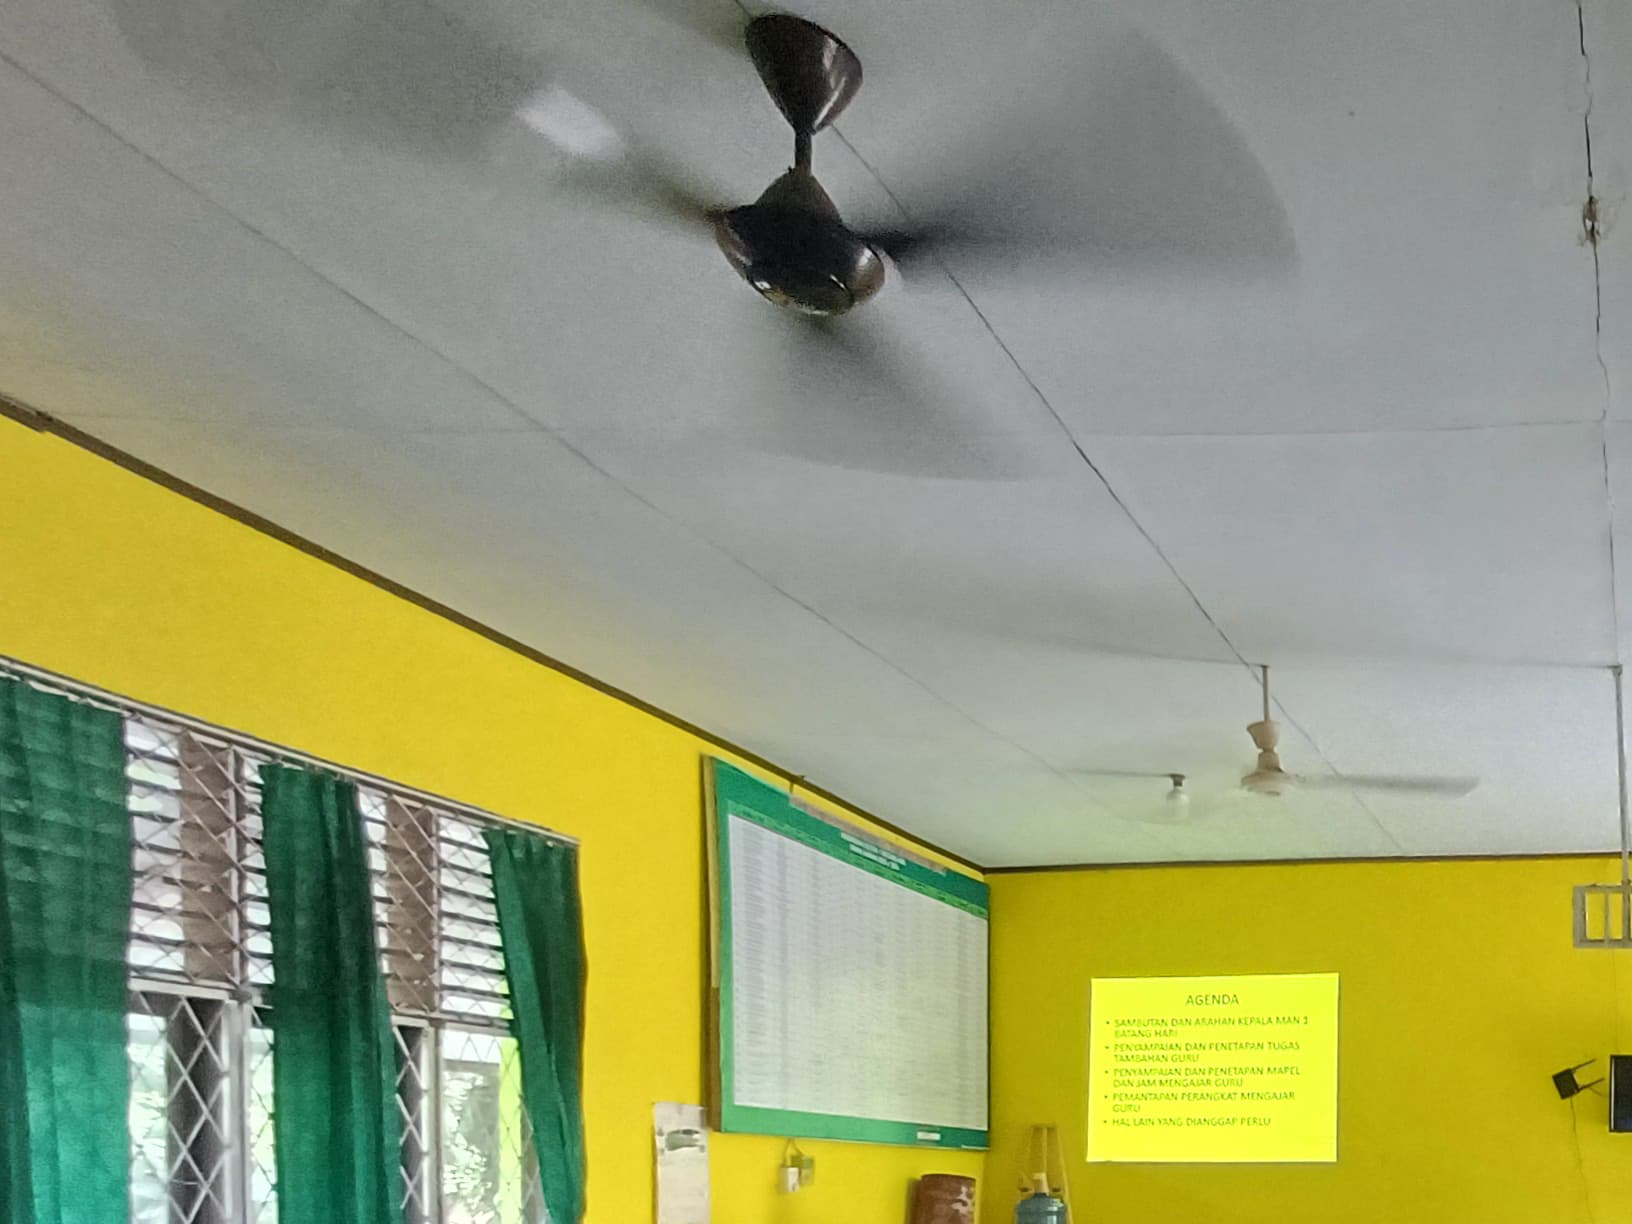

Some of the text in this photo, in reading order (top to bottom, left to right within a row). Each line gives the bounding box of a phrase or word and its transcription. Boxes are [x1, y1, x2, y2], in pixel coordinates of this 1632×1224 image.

[1185, 994, 1239, 1006] AGENDA
[1171, 1018, 1192, 1026] DAN
[1194, 1017, 1235, 1026] ARAHAN
[1238, 1017, 1273, 1025] KEPALA
[1275, 1016, 1300, 1025] MAN
[1114, 1041, 1300, 1051] PENYAMPAIAN DAN PENETAPAN TUGAS
[1171, 1054, 1199, 1062] GURU
[1113, 1067, 1300, 1076] PENYAMPAIAN DAN PENETAPAN MAPEL
[1113, 1078, 1243, 1088] DAN JAM MENGAJAR GURU
[1181, 1092, 1238, 1101] PERANGKAT
[1240, 1091, 1295, 1100] MENGAJAR
[1112, 1104, 1140, 1112] GURU
[1112, 1117, 1271, 1126] HAL LAIN YANG DIANGGAP PERLU
